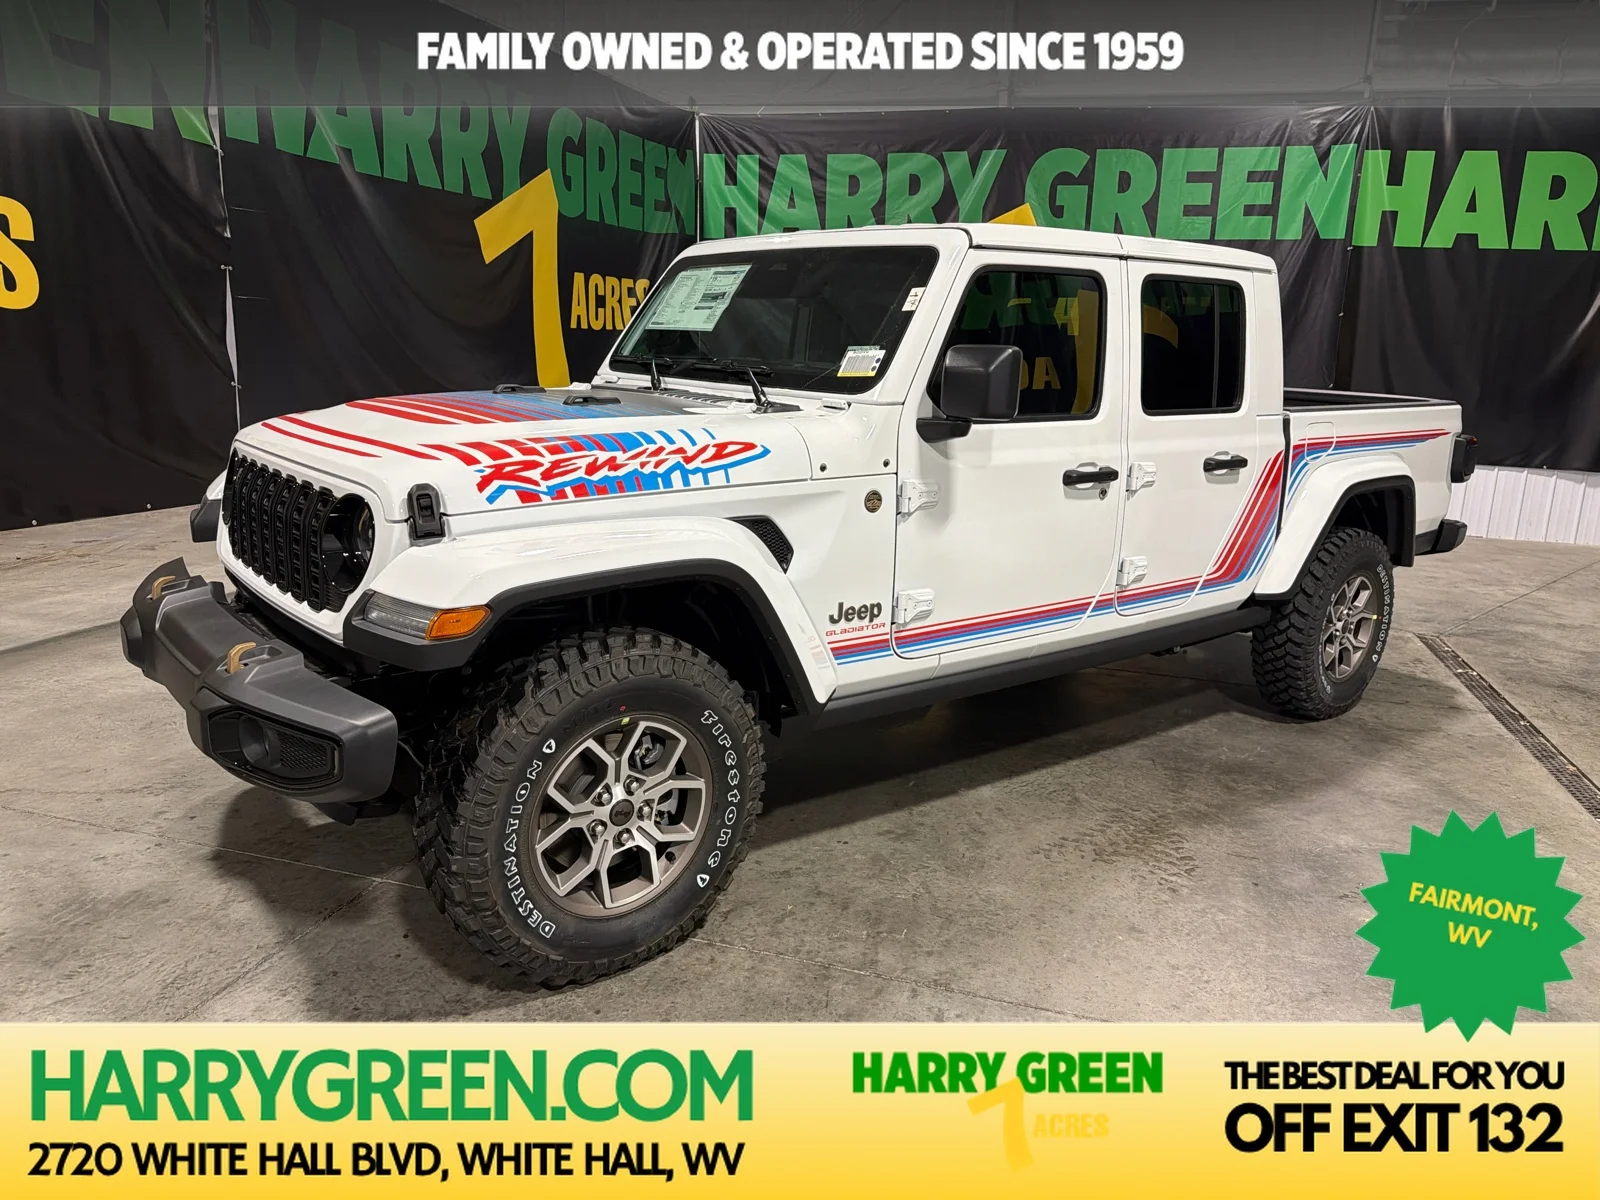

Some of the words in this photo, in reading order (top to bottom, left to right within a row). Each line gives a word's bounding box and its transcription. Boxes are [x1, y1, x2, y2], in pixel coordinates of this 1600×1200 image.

[216, 0, 531, 200] HARRY
[546, 107, 696, 236] GREEN
[703, 149, 1007, 239] HARRY
[1025, 144, 1358, 240] GREEN
[1352, 149, 1600, 251] HAR
[475, 440, 759, 494] REWIND
[828, 601, 883, 625] Jeep
[1376, 563, 1391, 652] DESTINATION
[503, 759, 556, 939] DESTINATION
